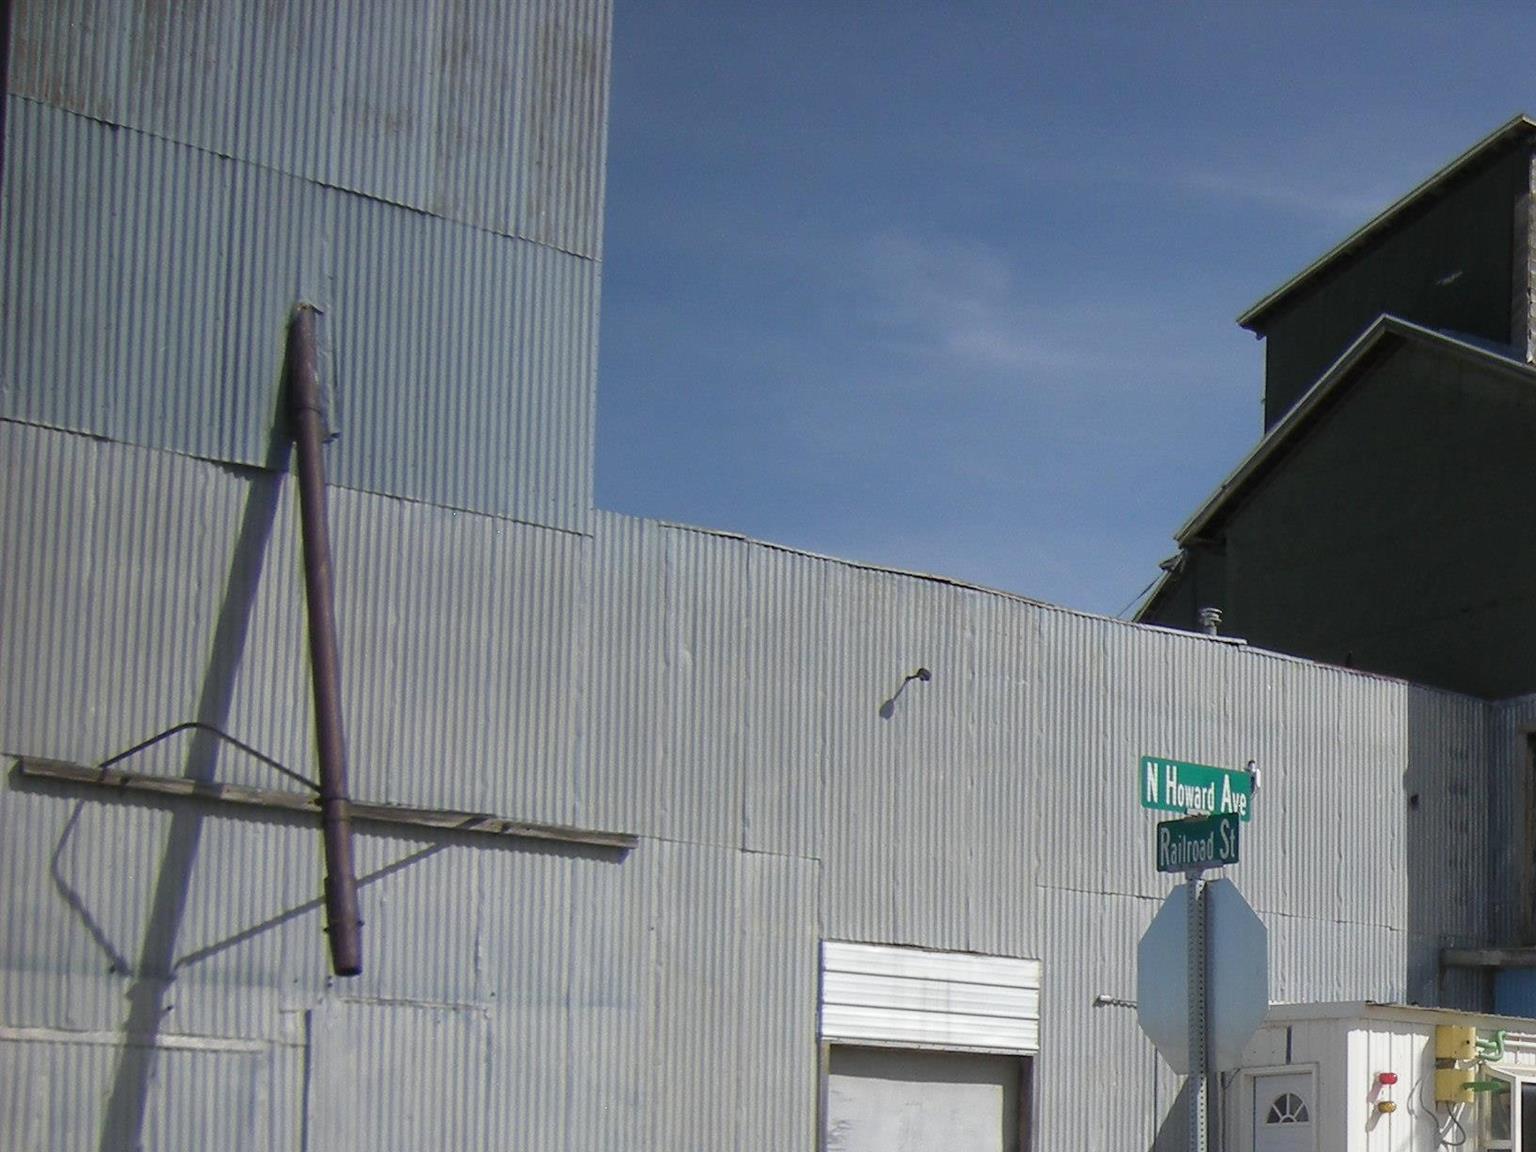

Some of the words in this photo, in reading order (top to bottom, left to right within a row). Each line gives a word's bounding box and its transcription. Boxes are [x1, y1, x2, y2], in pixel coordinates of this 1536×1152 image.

[1146, 761, 1159, 803] N
[1165, 764, 1215, 812] Howard
[1220, 773, 1247, 816] Ave
[1160, 827, 1214, 867] Railroad
[1219, 818, 1236, 860] St
